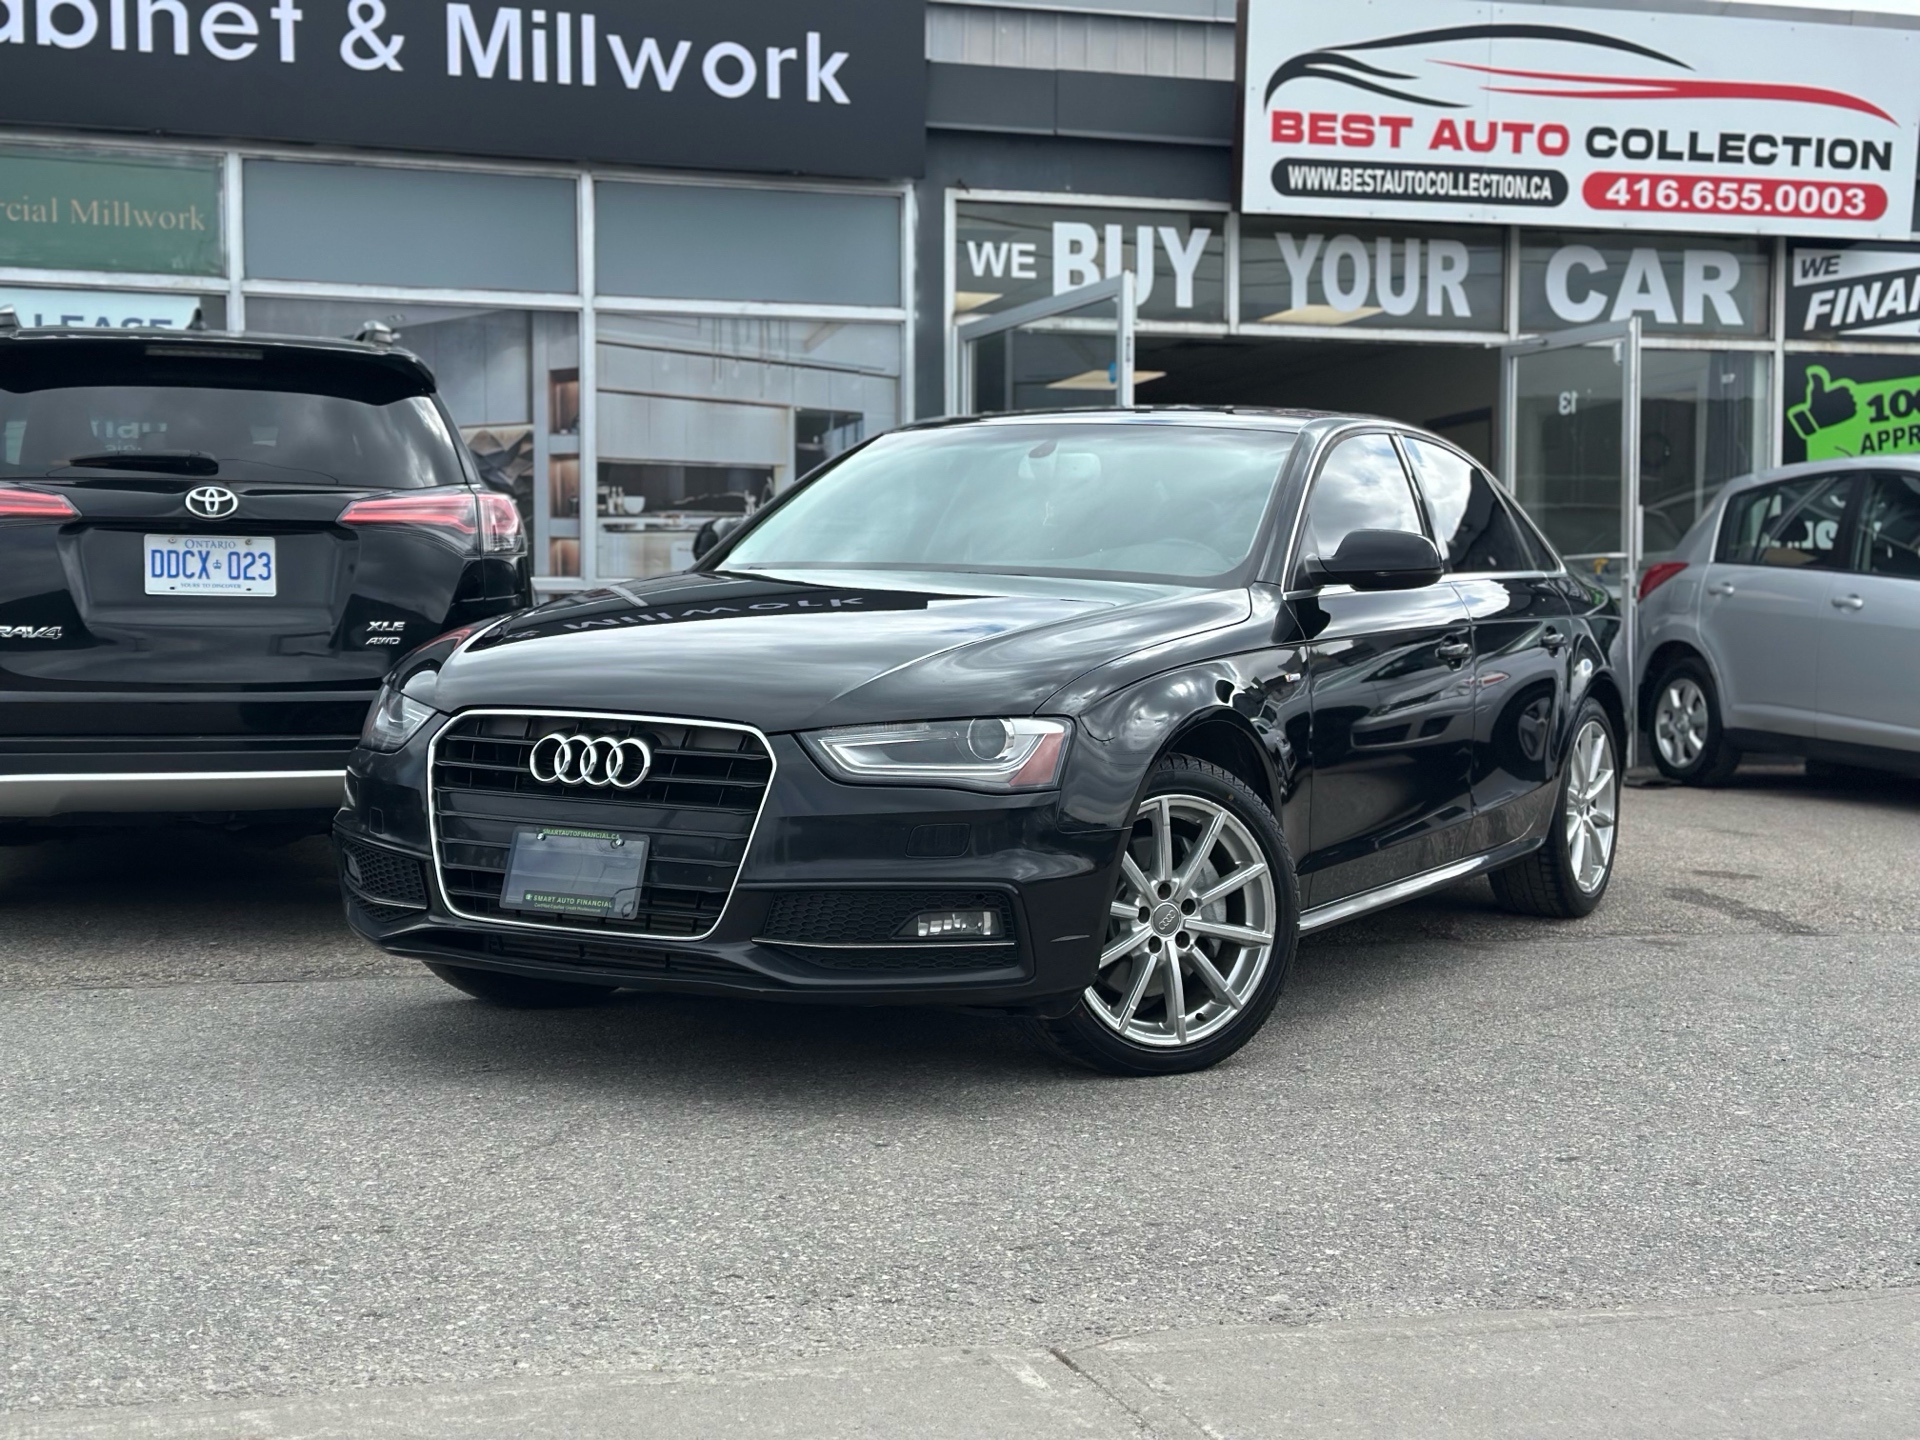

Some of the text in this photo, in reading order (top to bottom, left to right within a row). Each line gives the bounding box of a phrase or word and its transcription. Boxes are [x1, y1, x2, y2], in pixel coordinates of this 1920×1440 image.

[339, 0, 405, 71] &
[446, 2, 851, 104] Millwork
[1271, 110, 1892, 171] BEST AUTO COLLECTION
[1287, 165, 1553, 200] WWW.BESTAUTOCOLLECTION.CA
[1605, 177, 1866, 216] 416.655.0003
[0, 195, 205, 231] cial Millwork
[967, 222, 1744, 325] WE BUY YOUR CAR
[1801, 254, 1841, 279] WE
[1867, 388, 1920, 423] 10
[184, 539, 236, 550] ONTARIO
[151, 549, 271, 581] DDCX 023
[365, 636, 401, 645] AWD
[366, 621, 406, 632] XLE
[533, 894, 555, 903] SMART
[556, 897, 575, 905] AUTO
[576, 899, 613, 908] FINANCIAL
